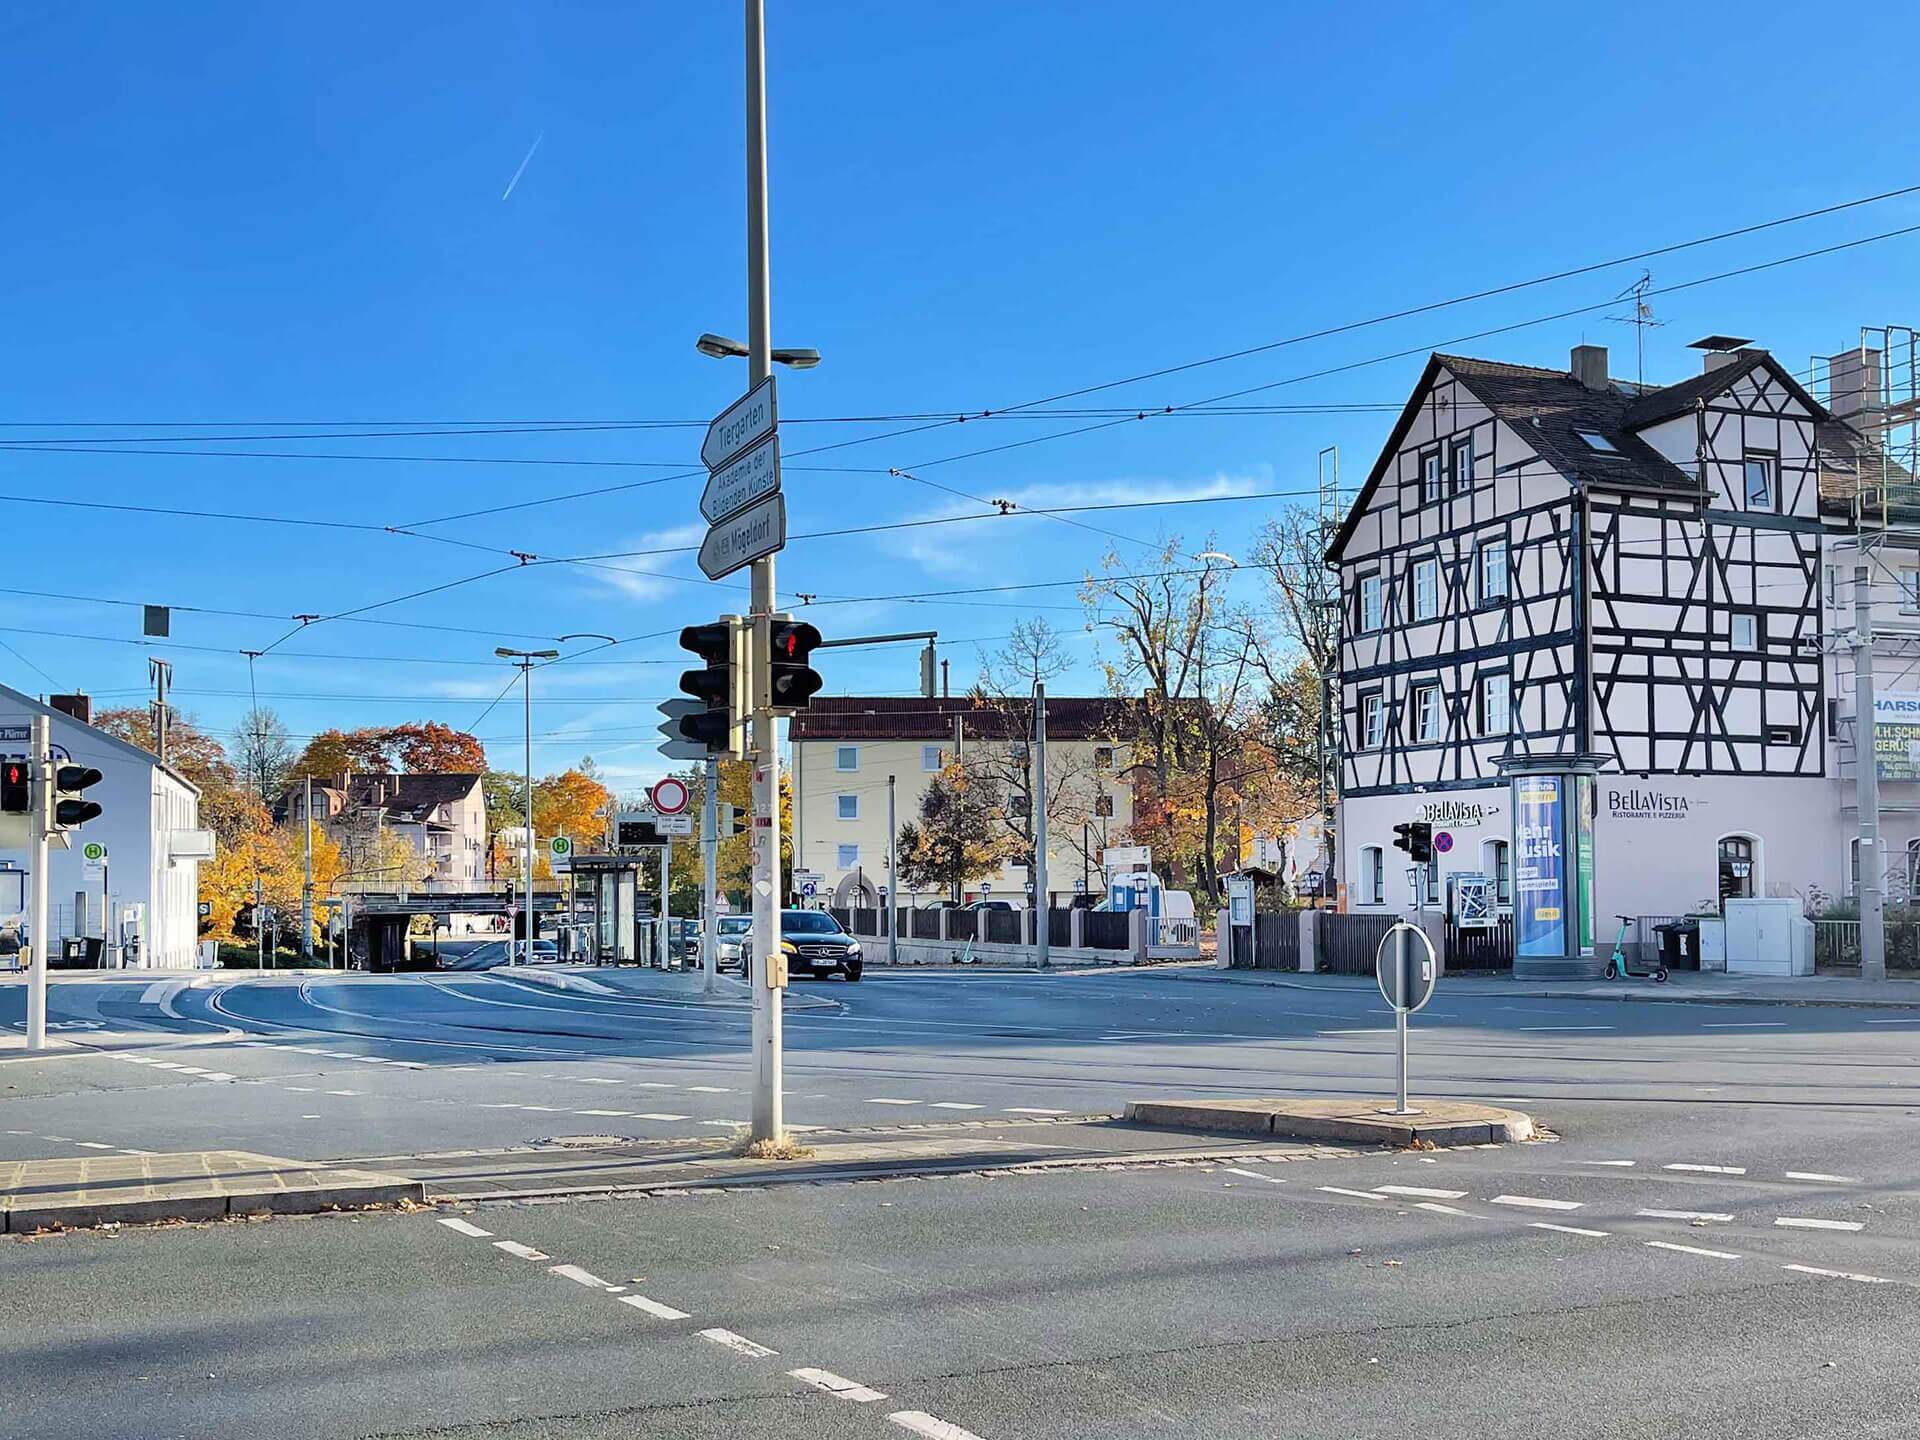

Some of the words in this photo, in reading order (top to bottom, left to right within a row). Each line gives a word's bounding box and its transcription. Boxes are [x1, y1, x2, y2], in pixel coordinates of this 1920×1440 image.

[718, 403, 764, 450] Tiergarten
[718, 459, 752, 489] Akademie
[753, 450, 767, 470] der
[748, 470, 774, 497] Künste
[731, 511, 770, 554] Mögeldorf
[1873, 700, 1920, 712] HARS
[1875, 738, 1910, 752] GERÜS
[88, 847, 98, 856] H
[556, 841, 565, 850] H
